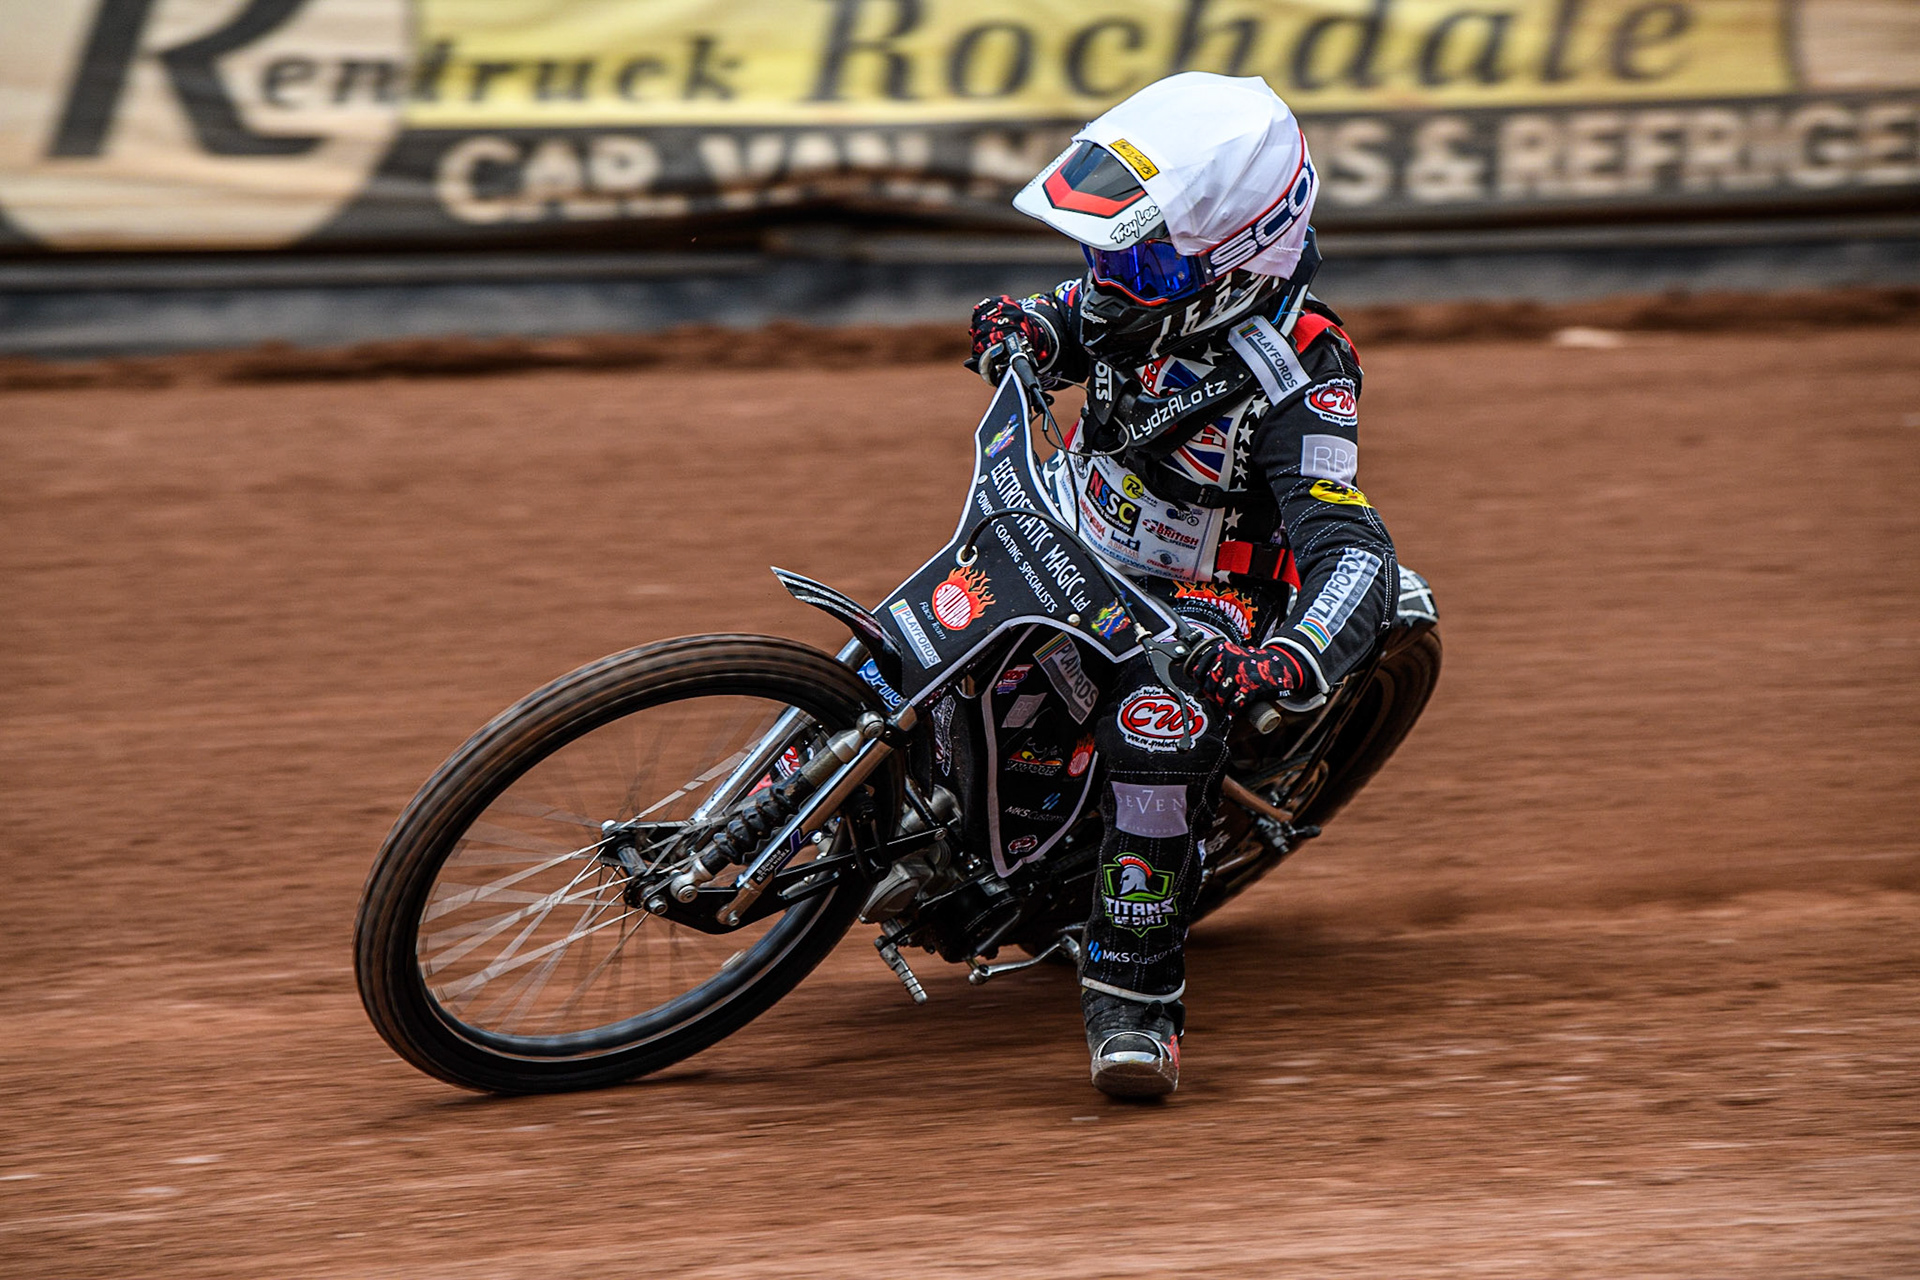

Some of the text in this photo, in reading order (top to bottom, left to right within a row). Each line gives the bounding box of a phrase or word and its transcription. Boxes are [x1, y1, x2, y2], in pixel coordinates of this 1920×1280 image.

[803, 0, 1702, 104] Rochdale
[1412, 117, 1490, 202] &
[1110, 205, 1161, 245] Troy Lee
[1252, 331, 1299, 390] PLAYFORDS
[1089, 469, 1137, 526] NSSC
[1156, 523, 1200, 547] BRITISH
[994, 522, 1024, 564] COATING
[1018, 561, 1059, 615] SPECIALISTS
[1041, 543, 1086, 596] MAGIC
[1069, 590, 1092, 613] Ltd
[902, 609, 940, 664] PLAYFORDS
[918, 600, 935, 622] Race
[1103, 895, 1175, 917] TITANS
